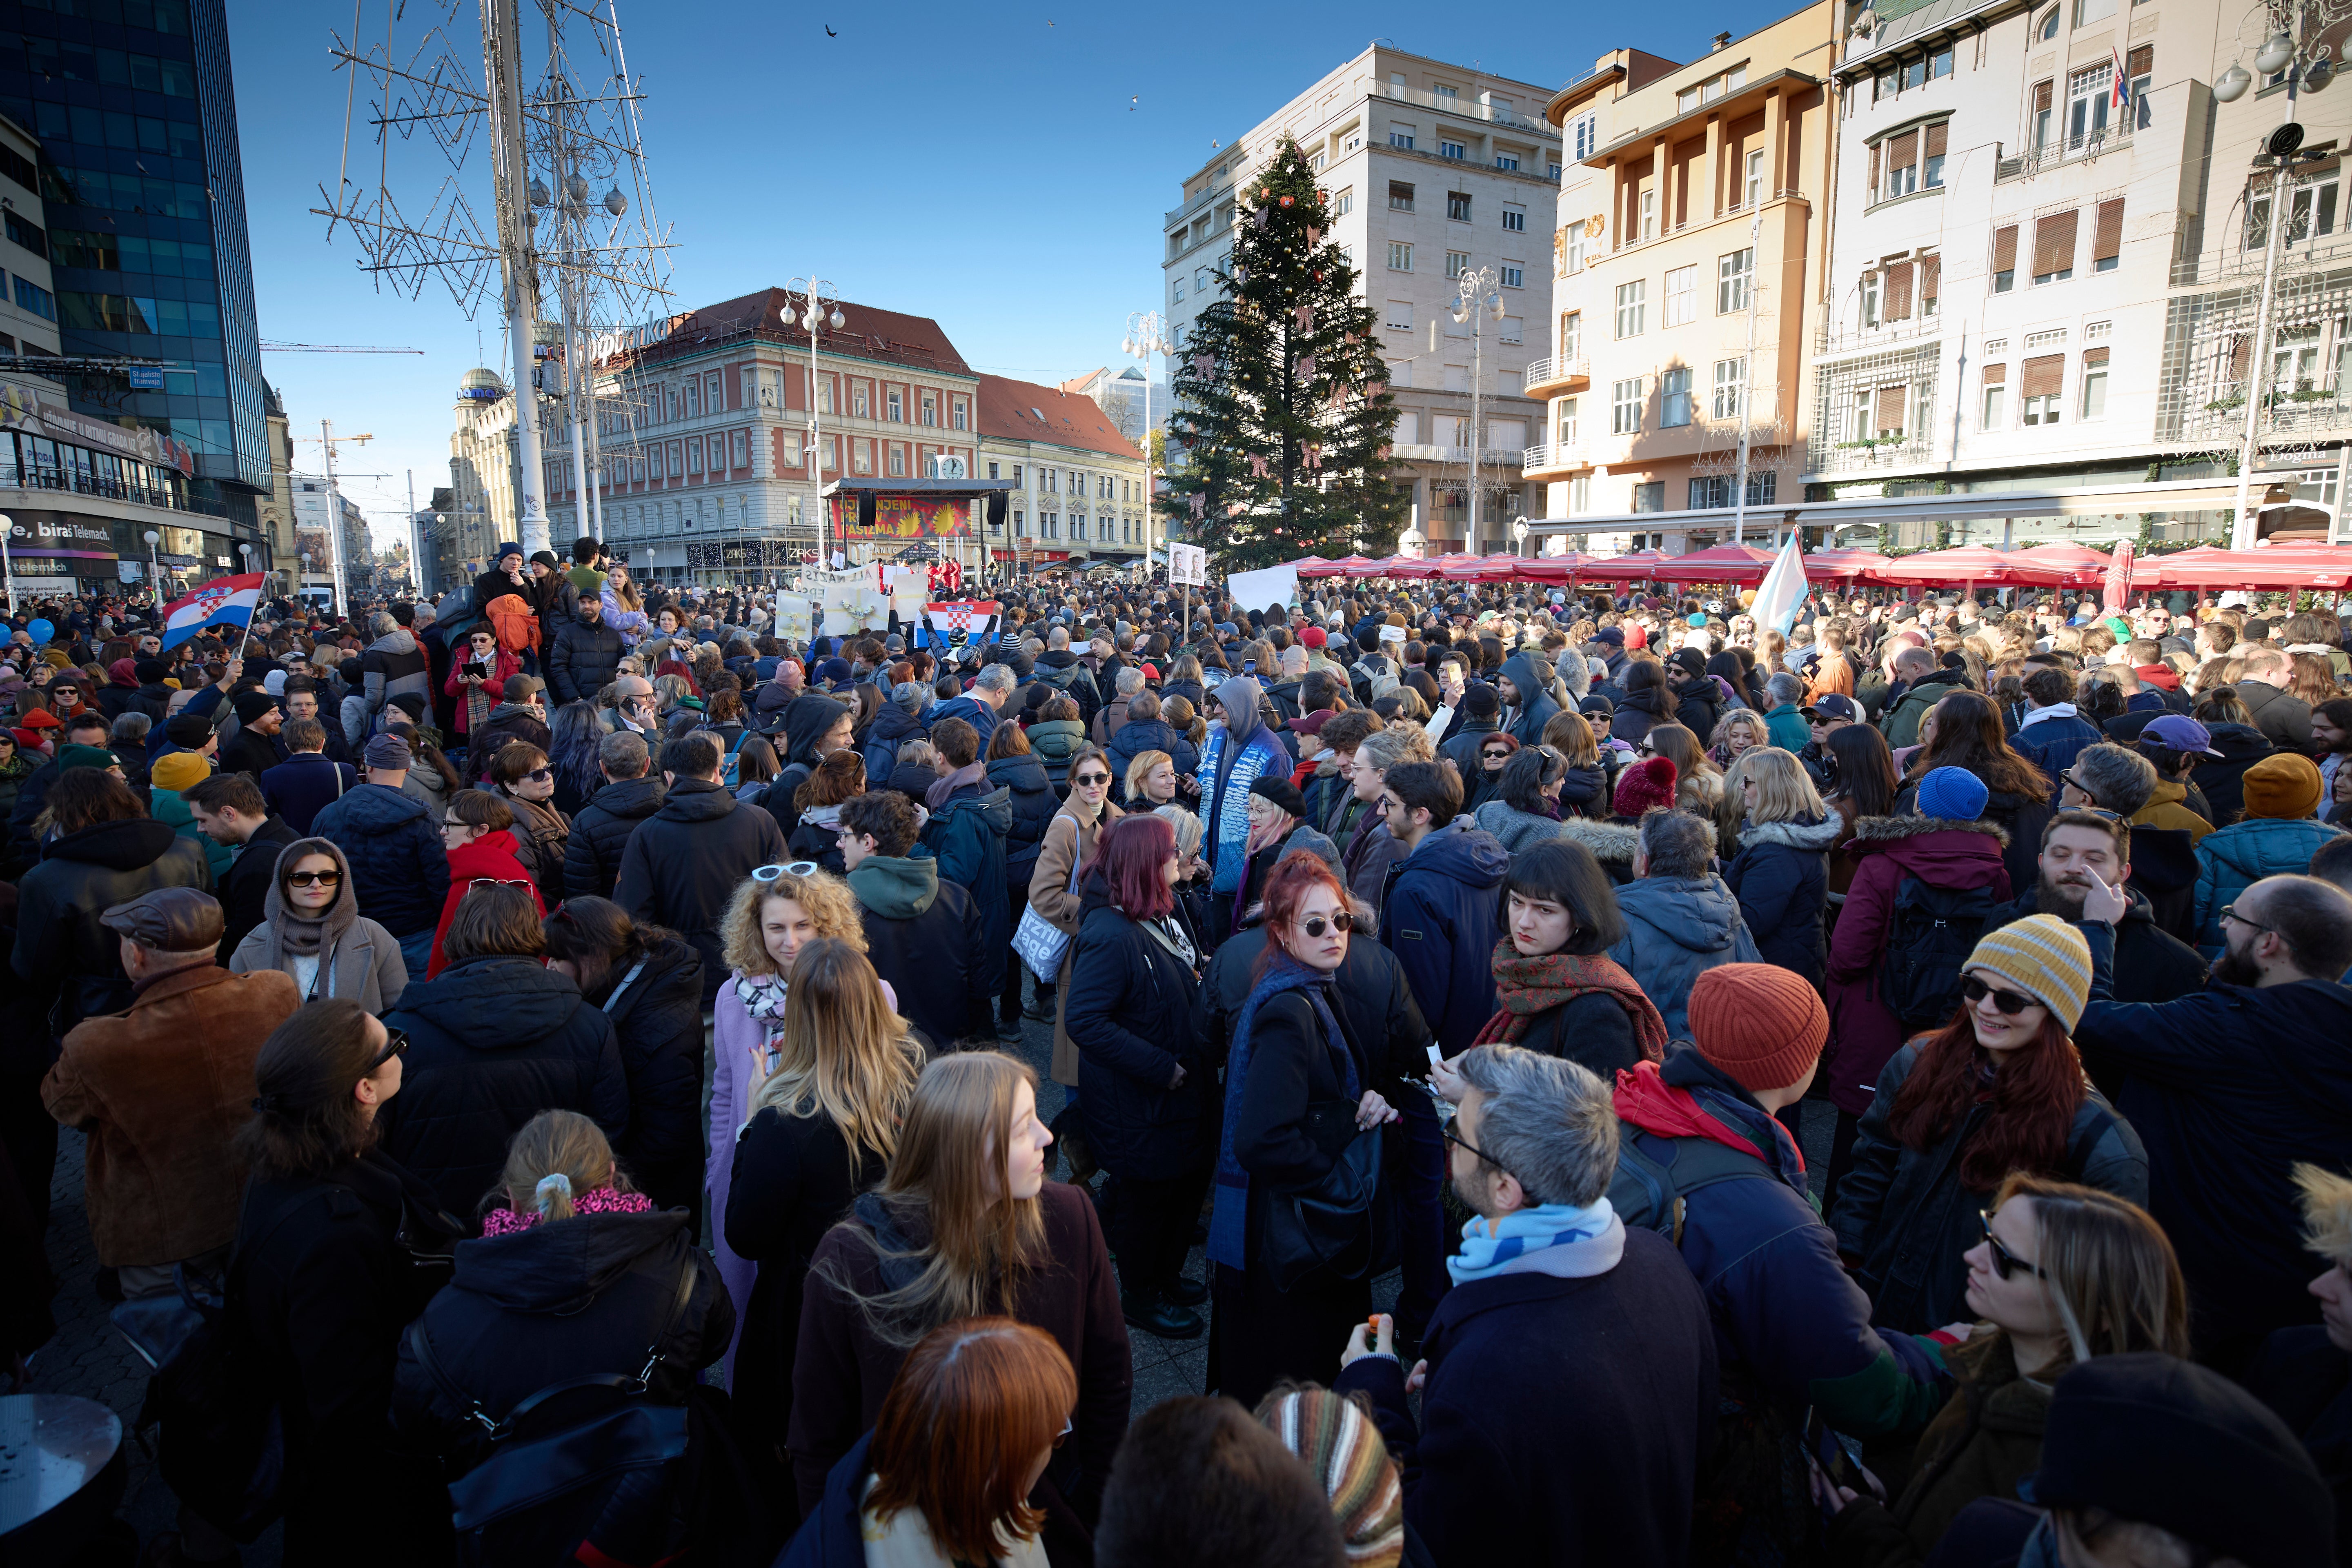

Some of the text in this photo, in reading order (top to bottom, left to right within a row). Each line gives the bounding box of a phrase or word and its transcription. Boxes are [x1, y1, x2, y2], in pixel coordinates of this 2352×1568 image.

[43, 410, 136, 451] UŽIVANJE U RITMU GRADA UZ
[839, 499, 911, 511] UJNJENI
[841, 512, 882, 523] PRV
[38, 522, 72, 538] biraš
[73, 524, 109, 540] Telemach.
[726, 549, 746, 558] ZAKS
[789, 548, 819, 558] ZAKS
[13, 563, 66, 572] telemach
